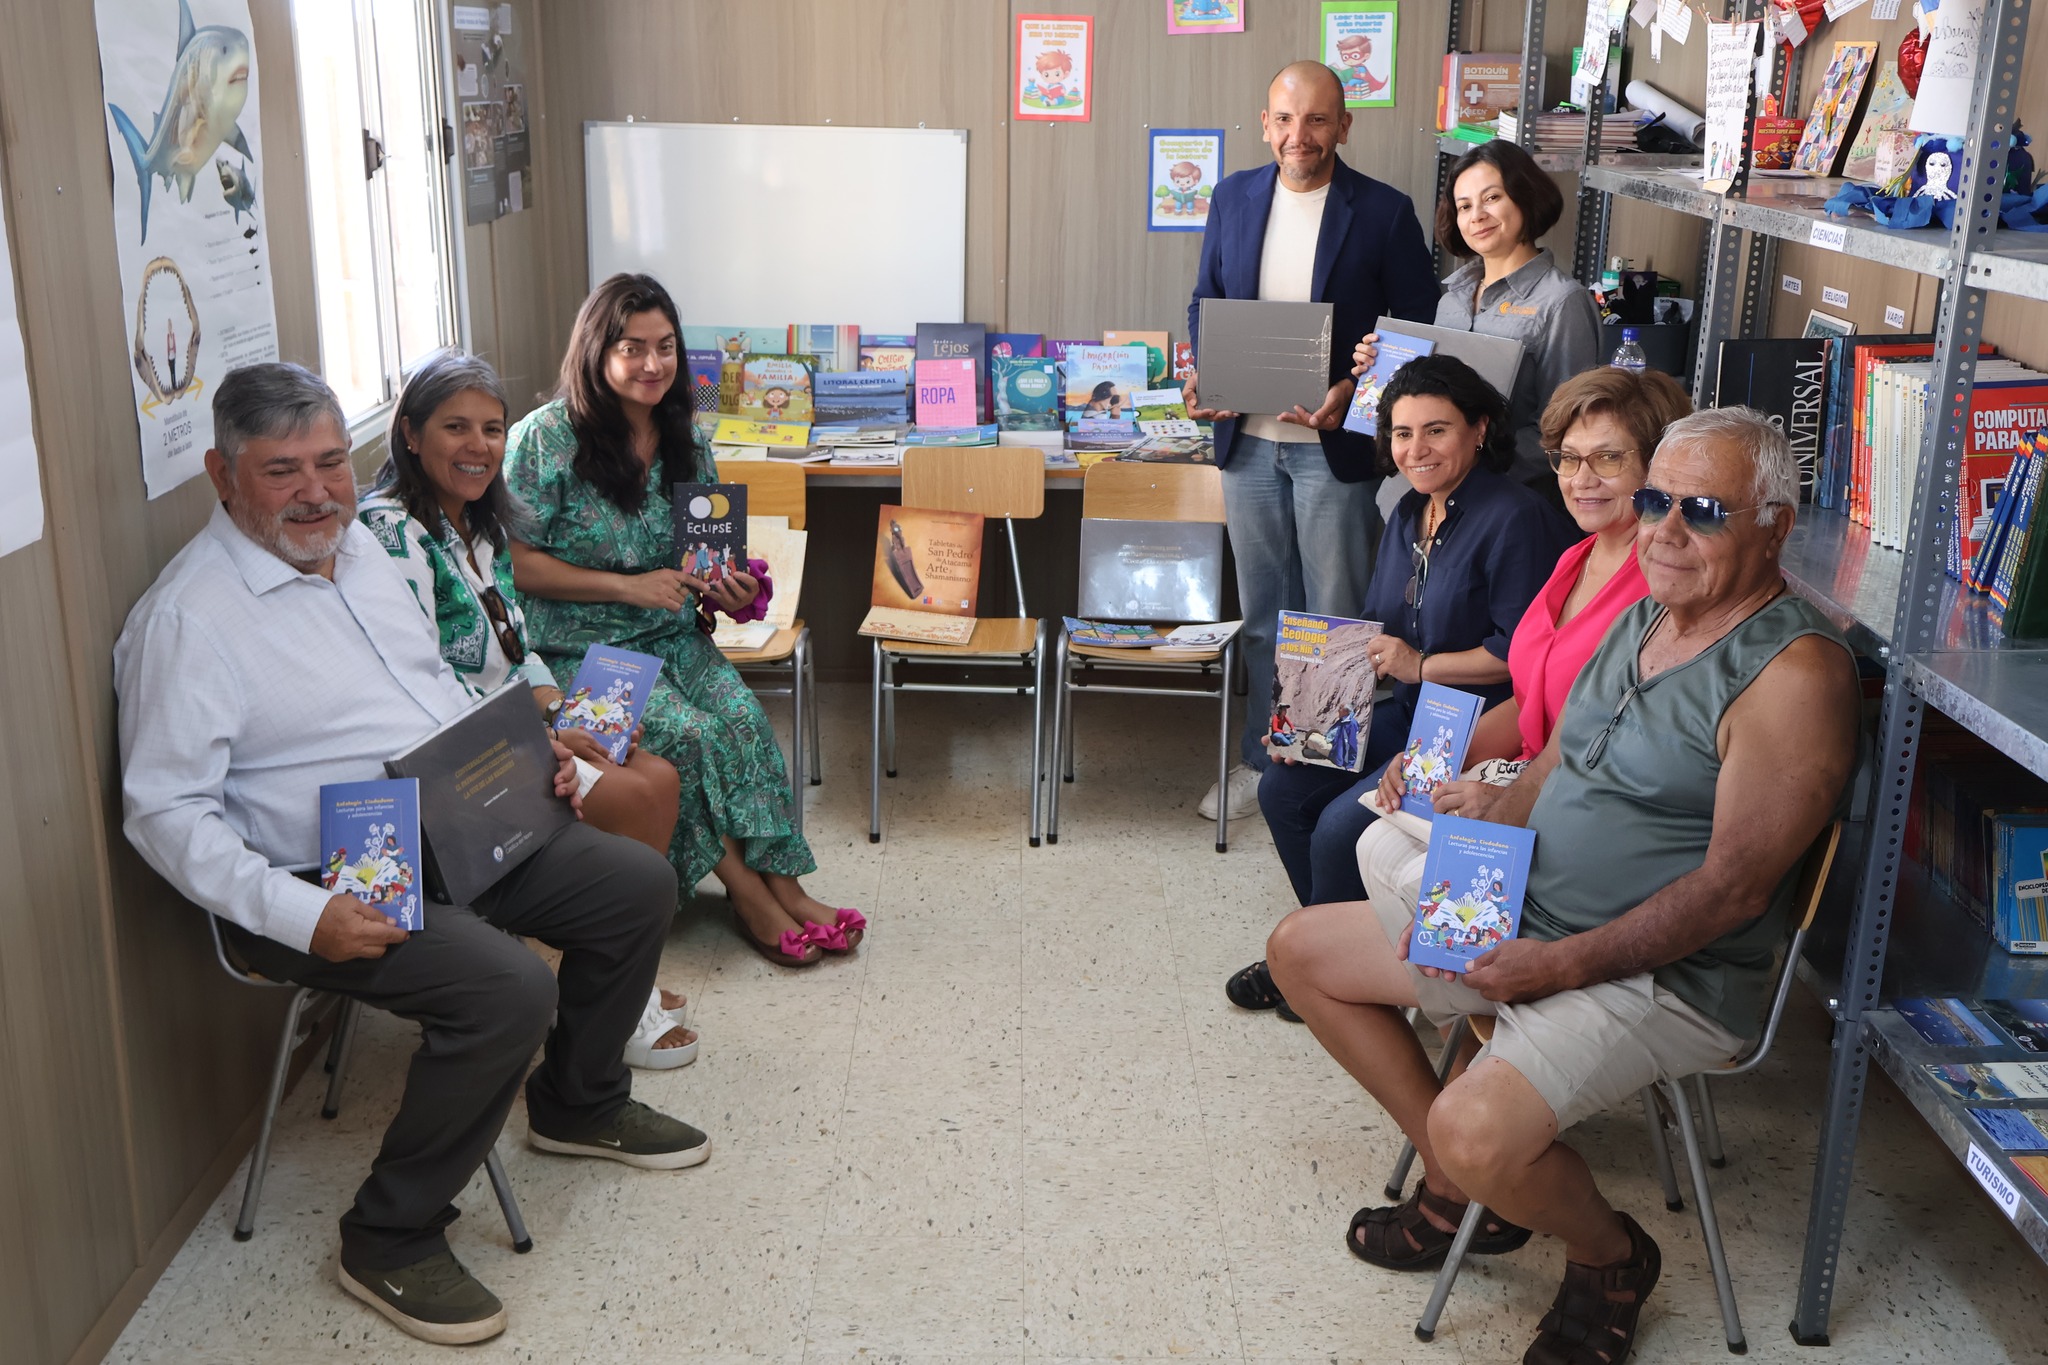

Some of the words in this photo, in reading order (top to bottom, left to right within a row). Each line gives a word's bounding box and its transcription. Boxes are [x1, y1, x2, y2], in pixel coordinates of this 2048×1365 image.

[1464, 65, 1508, 75] BOTIQUÍN
[1812, 228, 1844, 245] CIENCIAS
[1784, 280, 1799, 291] ARTES
[1824, 291, 1847, 304] RELIGION
[922, 387, 955, 404] ROPA
[1790, 351, 1824, 486] UNIVERSAL
[1974, 408, 2048, 430] COMPUTA
[168, 420, 192, 443] METROS
[1975, 430, 2019, 450] PARA
[687, 522, 732, 534] ECLIPSE
[929, 539, 956, 548] Tabletas
[928, 547, 944, 557] San
[947, 549, 972, 559] Pedro
[926, 563, 948, 573] Arte
[942, 559, 972, 567] Atacama
[925, 573, 971, 582] Shamanismo
[1283, 616, 1328, 630] Enseñando
[1282, 627, 1327, 644] Geología
[1287, 643, 1298, 652] los
[1448, 840, 1467, 848] Lecturas
[1487, 847, 1507, 855] infancias
[1449, 834, 1476, 844] Antología
[1480, 839, 1509, 849] Ciudadana
[1971, 1151, 2014, 1205] TURISMO
